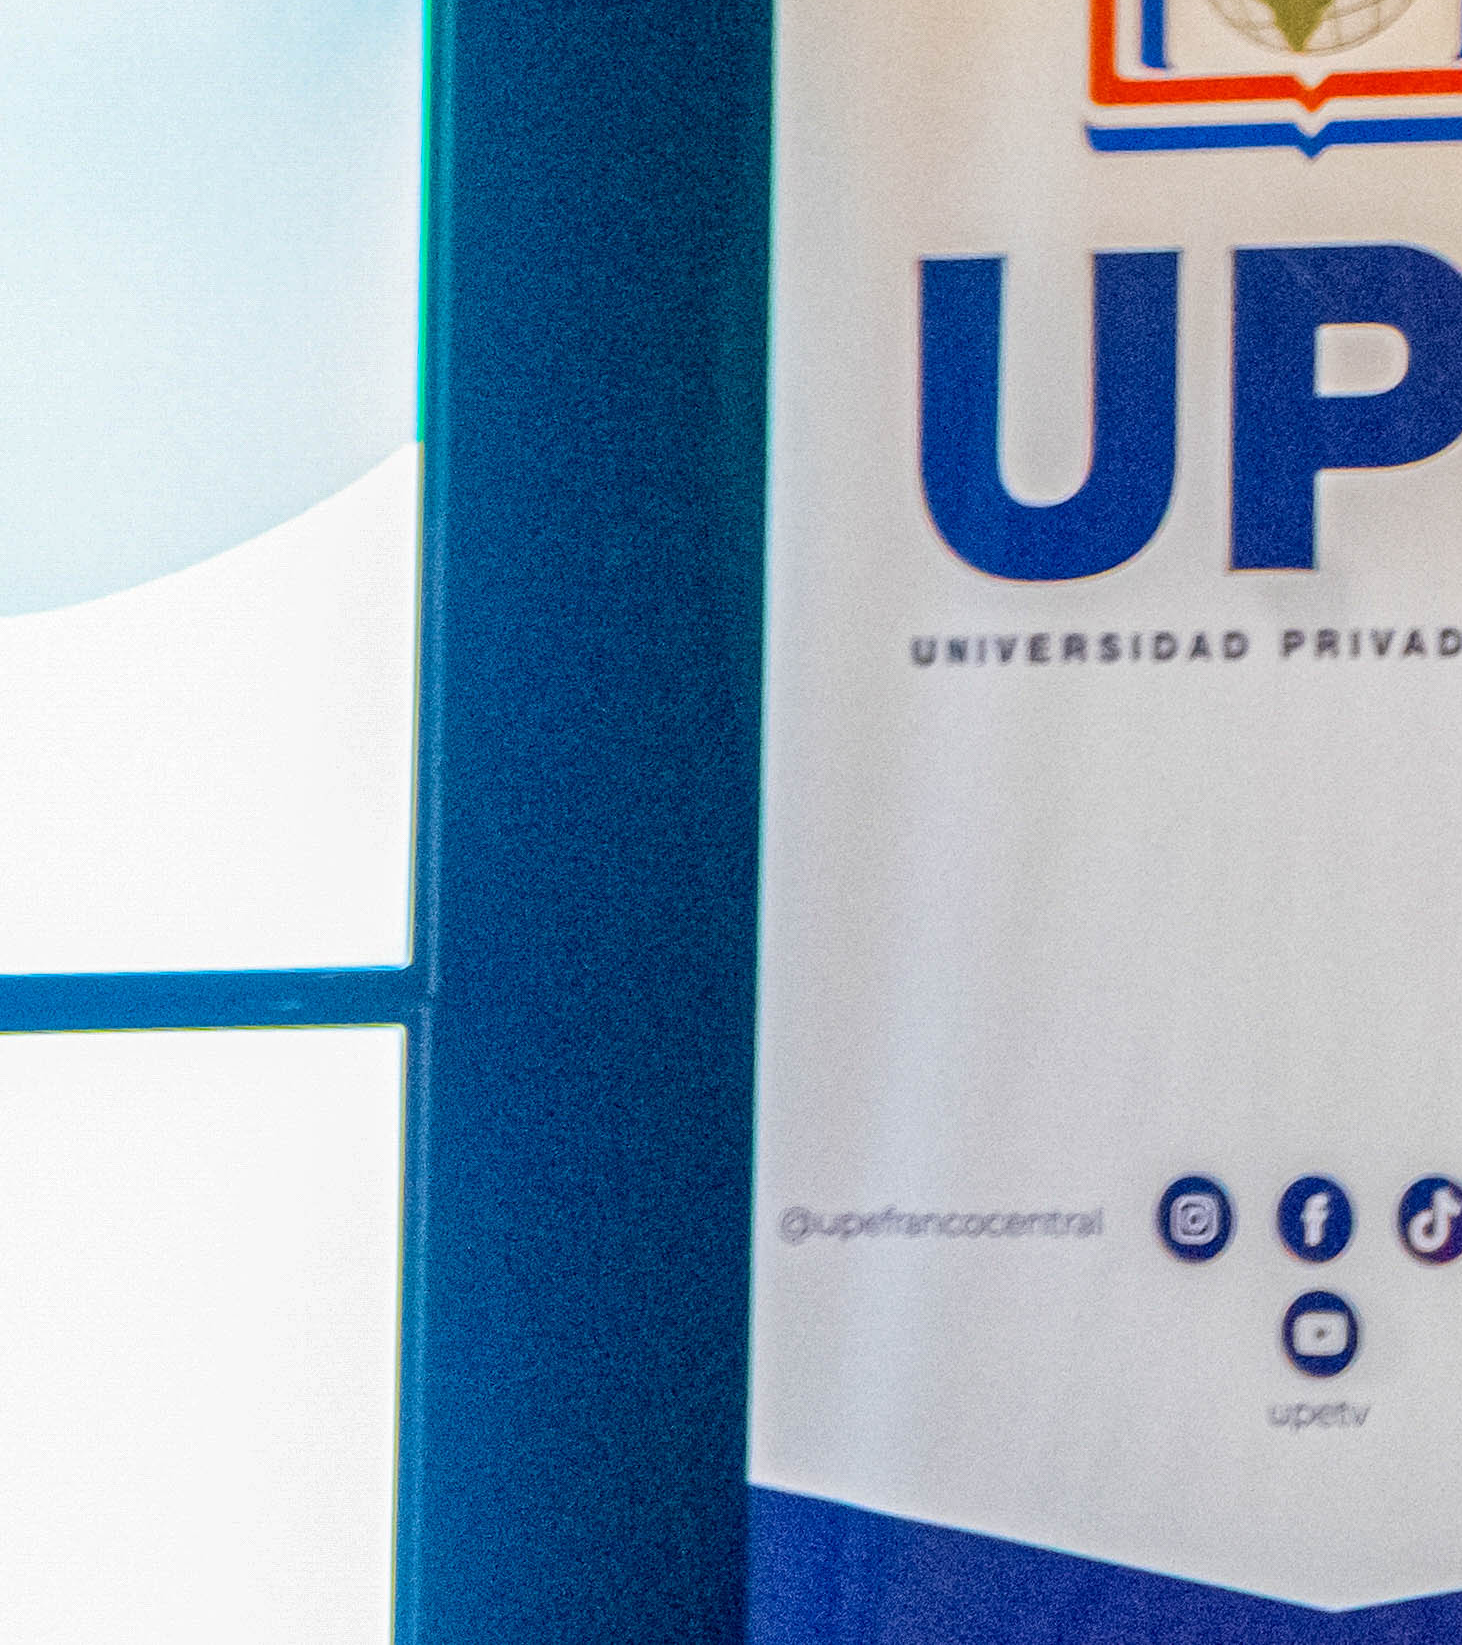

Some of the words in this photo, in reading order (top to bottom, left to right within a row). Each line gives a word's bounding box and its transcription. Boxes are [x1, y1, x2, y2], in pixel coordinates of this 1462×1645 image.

[911, 629, 1250, 668] UNIVERSIDAD
[778, 1205, 1104, 1245] @upefrancocentral
[1267, 1402, 1371, 1431] upetv
